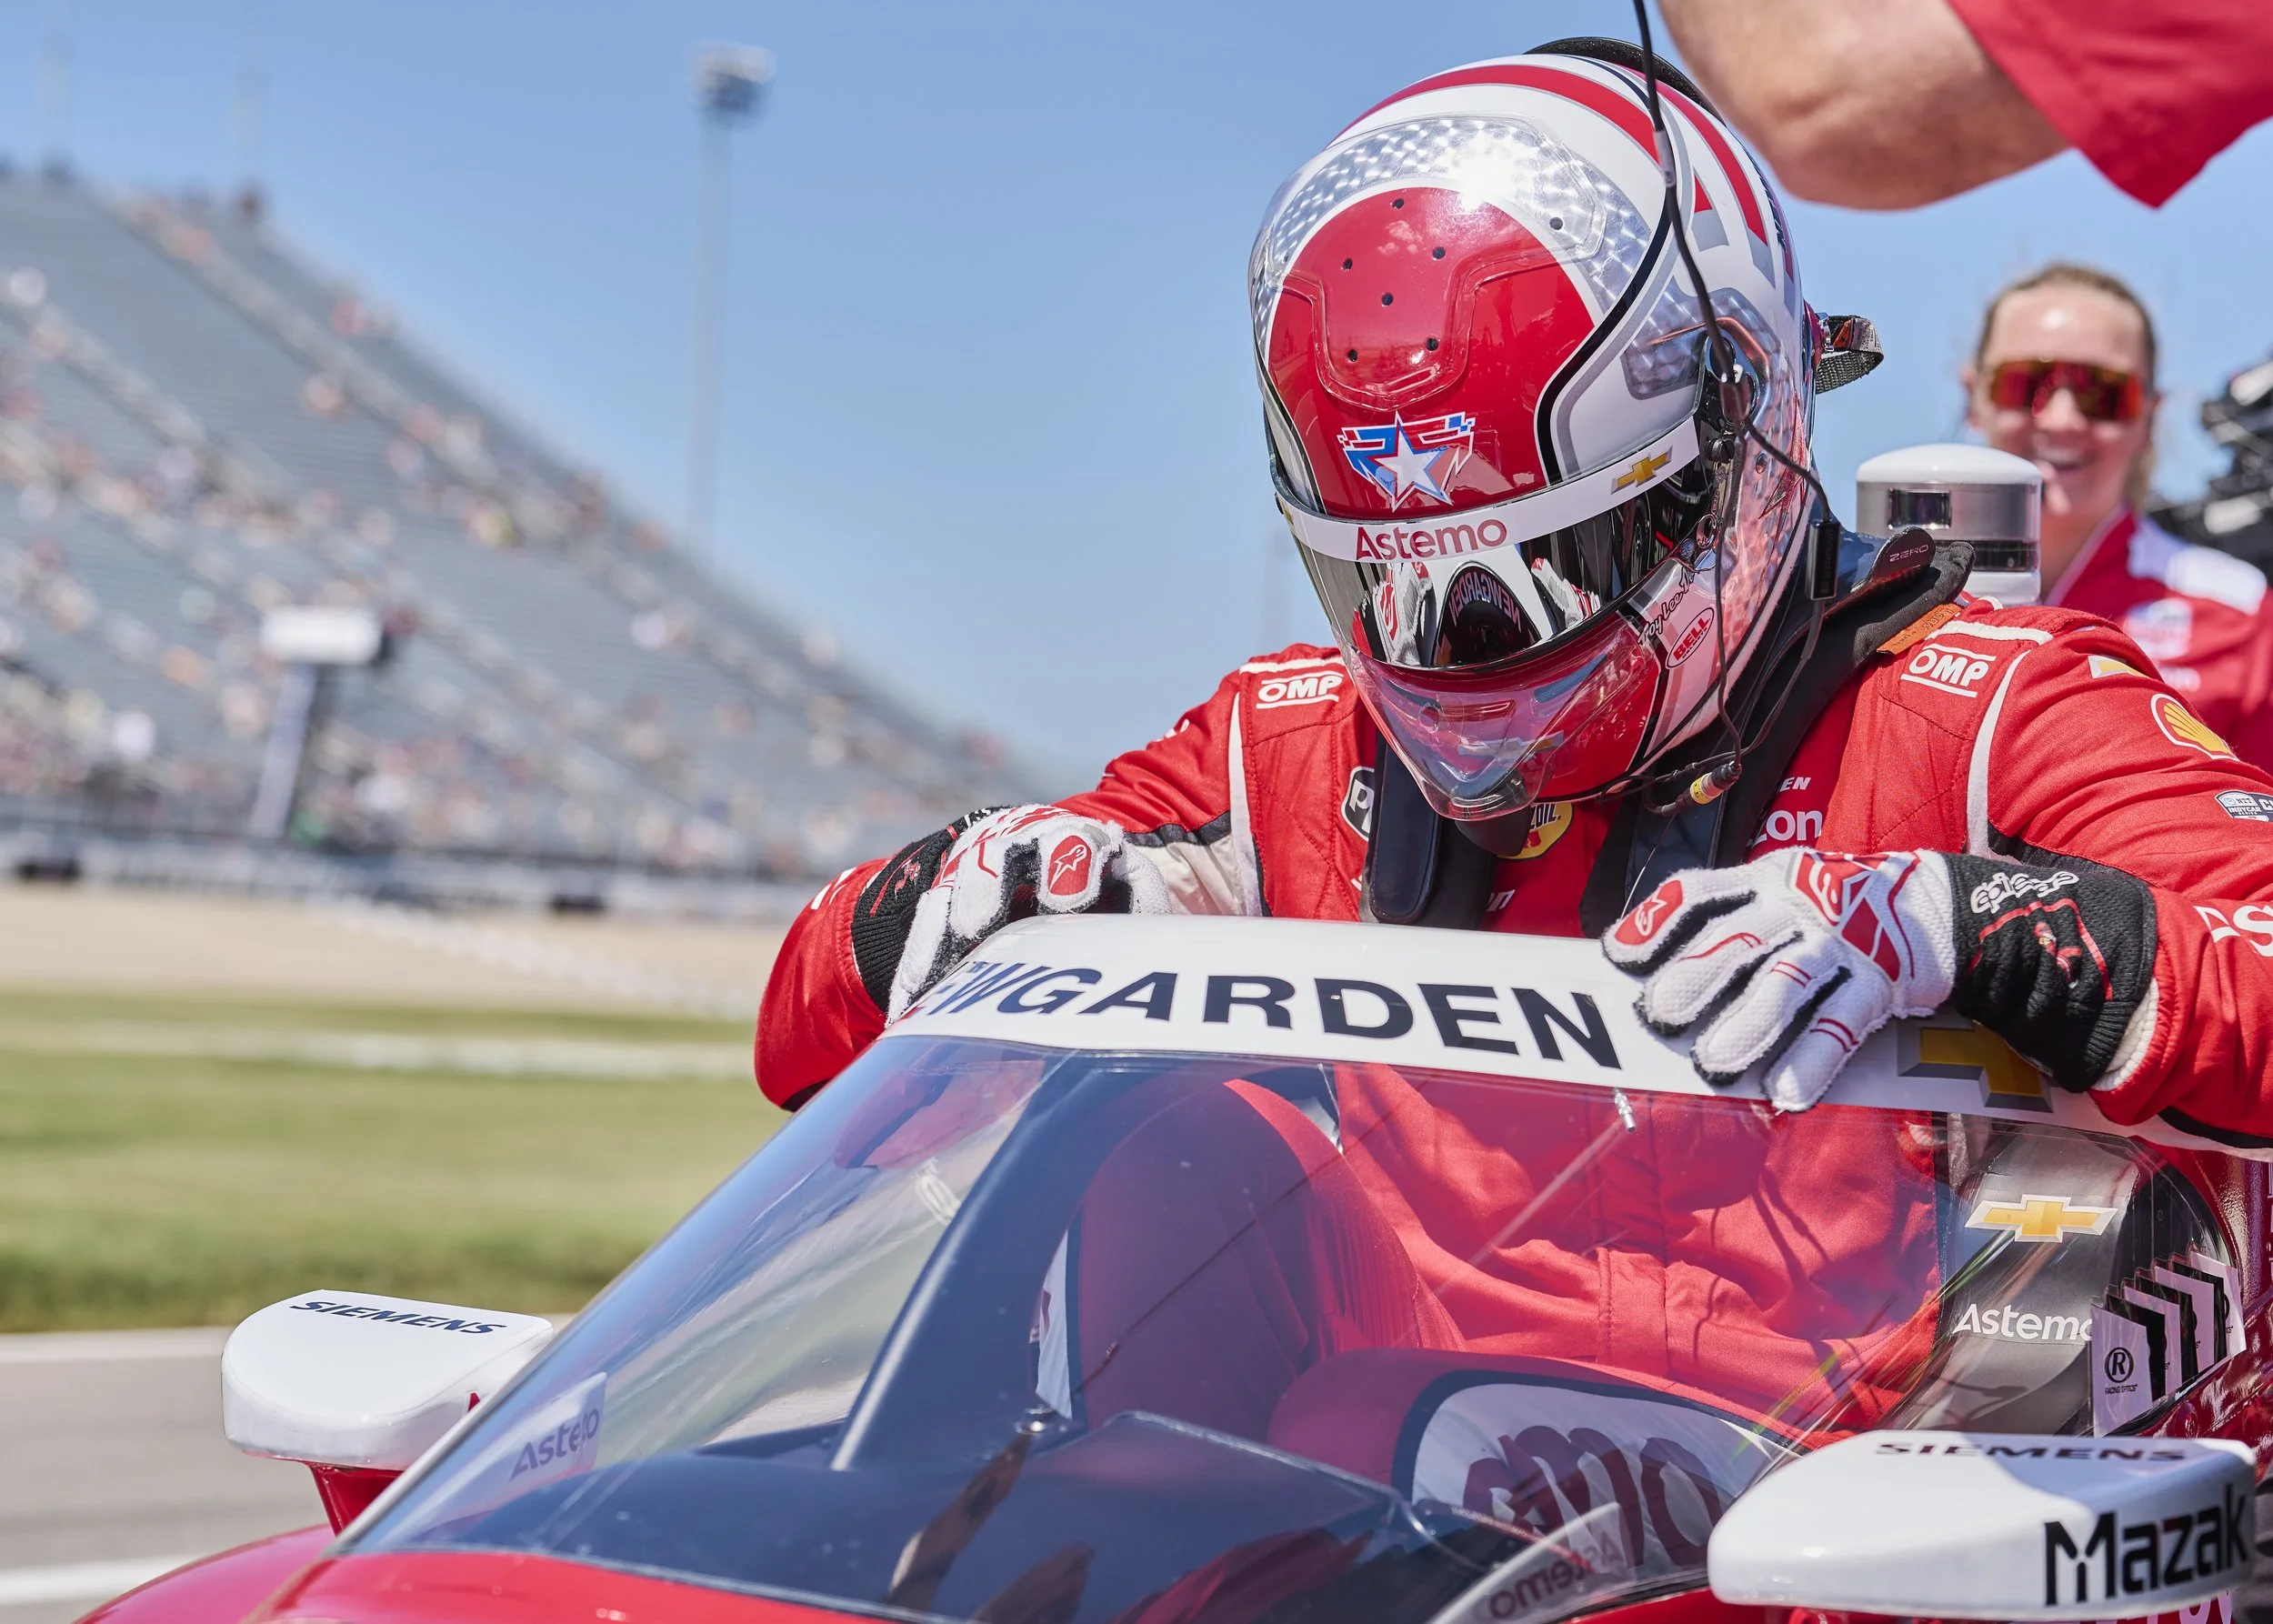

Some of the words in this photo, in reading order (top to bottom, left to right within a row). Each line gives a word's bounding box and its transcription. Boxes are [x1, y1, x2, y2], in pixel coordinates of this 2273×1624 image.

[1357, 519, 1507, 560] Astemo
[1889, 545, 1929, 562] ZERO
[1661, 592, 1683, 620] Lee
[1673, 617, 1707, 660] BELL
[1908, 649, 1988, 687] OMP
[1258, 676, 1343, 703] OMP
[1755, 810, 1823, 846] on
[290, 1301, 507, 1333] SIEMENS
[1877, 1443, 2186, 1461] SIEMENS
[2044, 1484, 2248, 1607] Mazak
